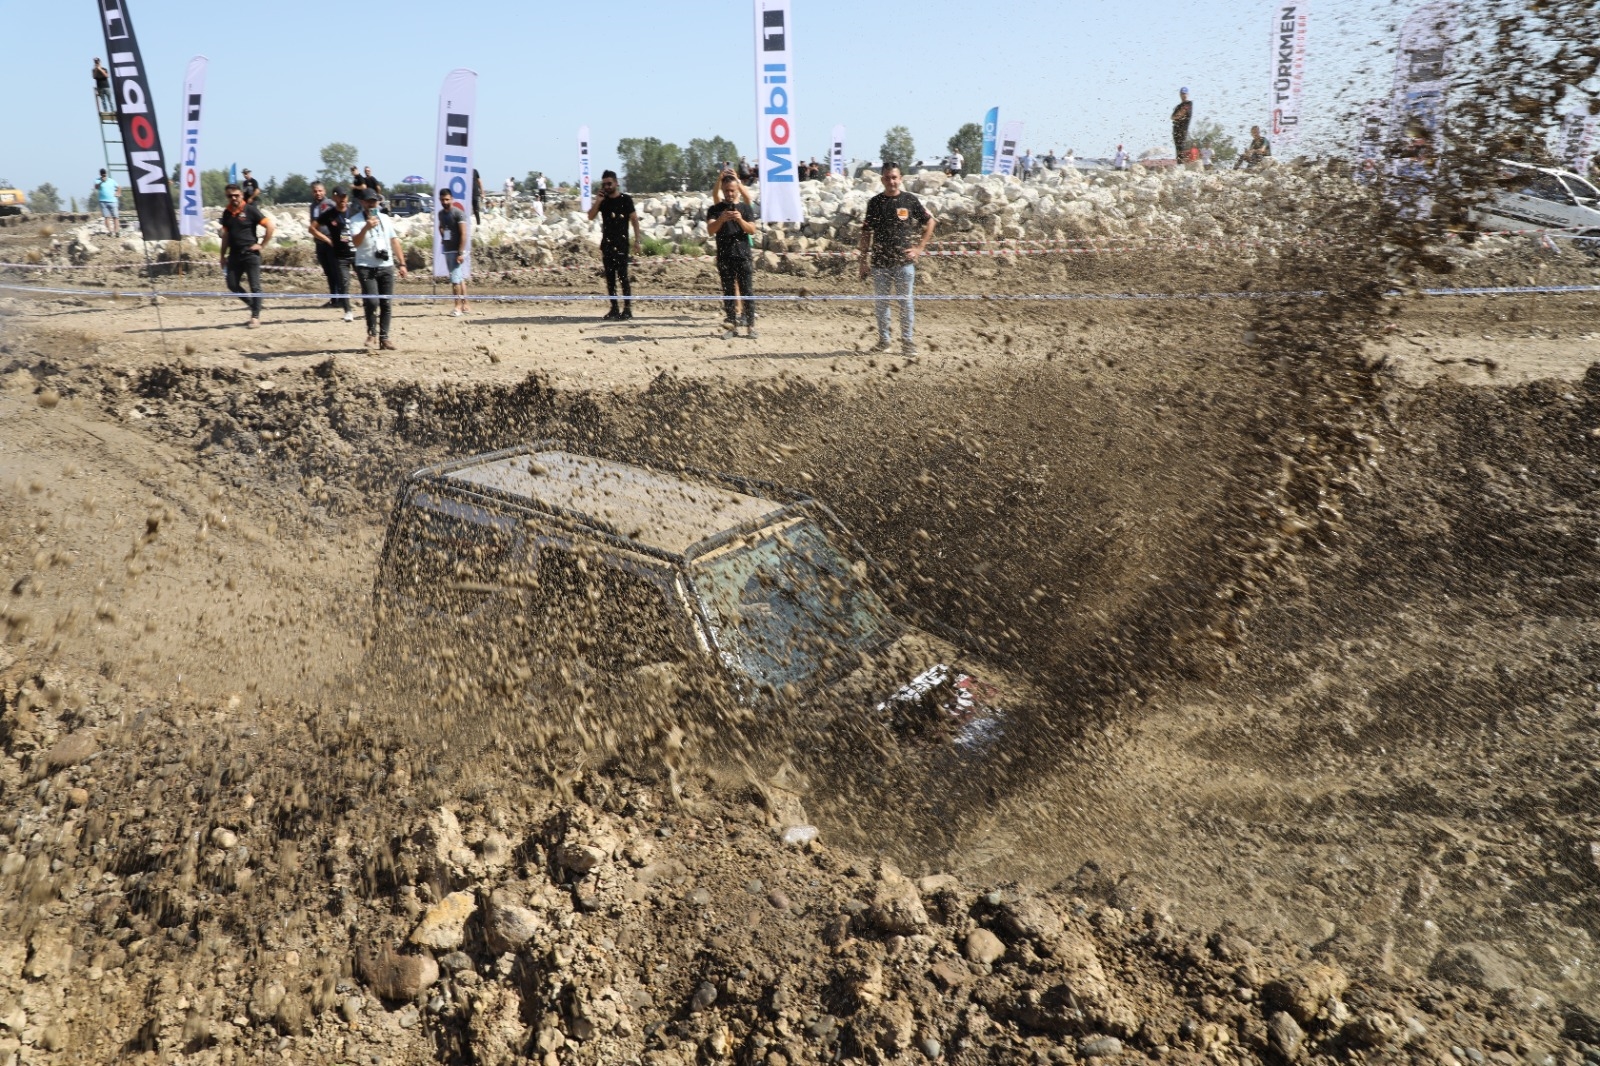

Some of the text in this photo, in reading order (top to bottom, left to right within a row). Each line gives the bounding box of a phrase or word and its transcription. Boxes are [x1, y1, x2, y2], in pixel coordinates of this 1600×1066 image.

[1274, 6, 1297, 105] TÜRKMEN
[111, 51, 167, 194] Mobil
[184, 129, 199, 216] Mobil
[764, 63, 794, 183] Mobil
